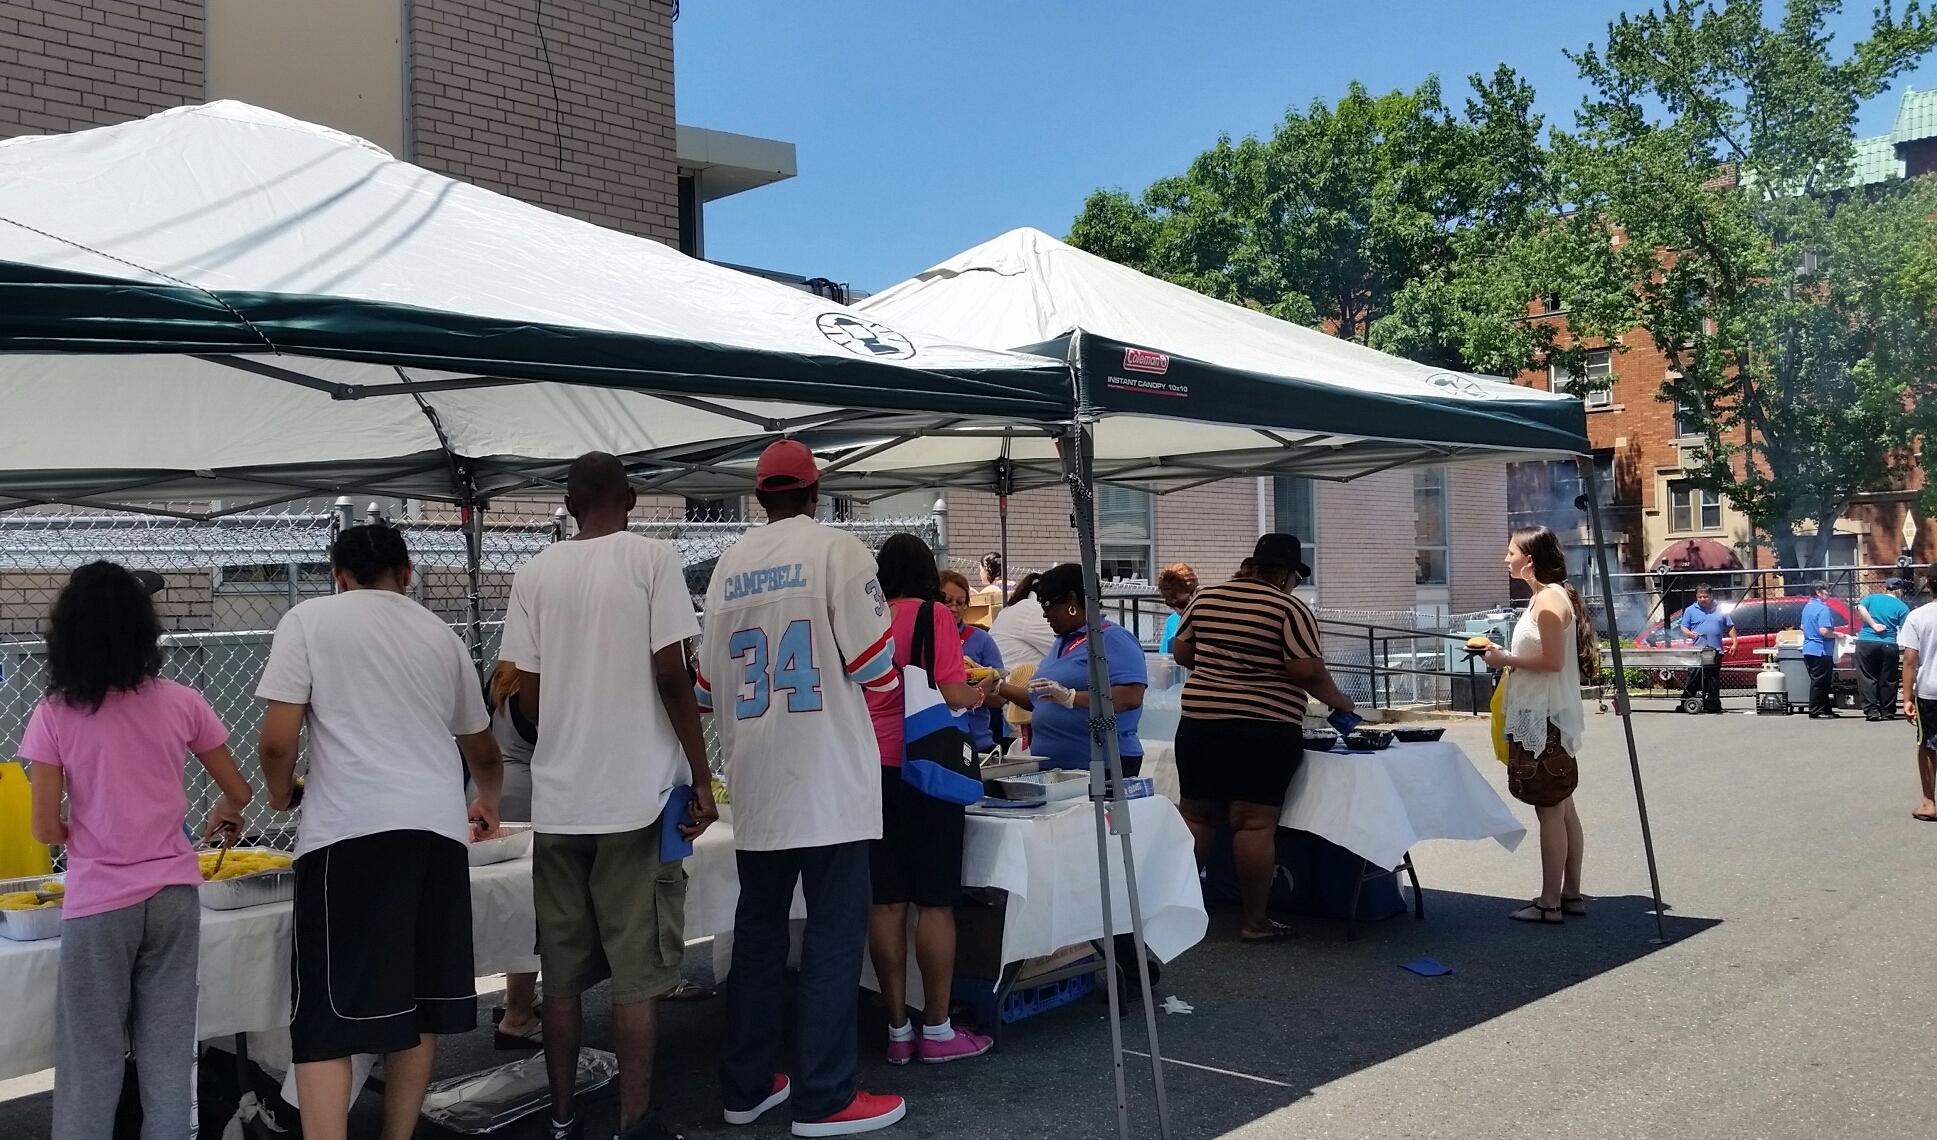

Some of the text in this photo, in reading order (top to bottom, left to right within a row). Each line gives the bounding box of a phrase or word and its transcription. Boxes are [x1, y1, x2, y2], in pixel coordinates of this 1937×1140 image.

[1127, 350, 1160, 367] Coleman
[1107, 375, 1188, 392] INSTANT CANOPY 10x10
[724, 563, 807, 601] CAMPBELL
[728, 619, 823, 721] 34
